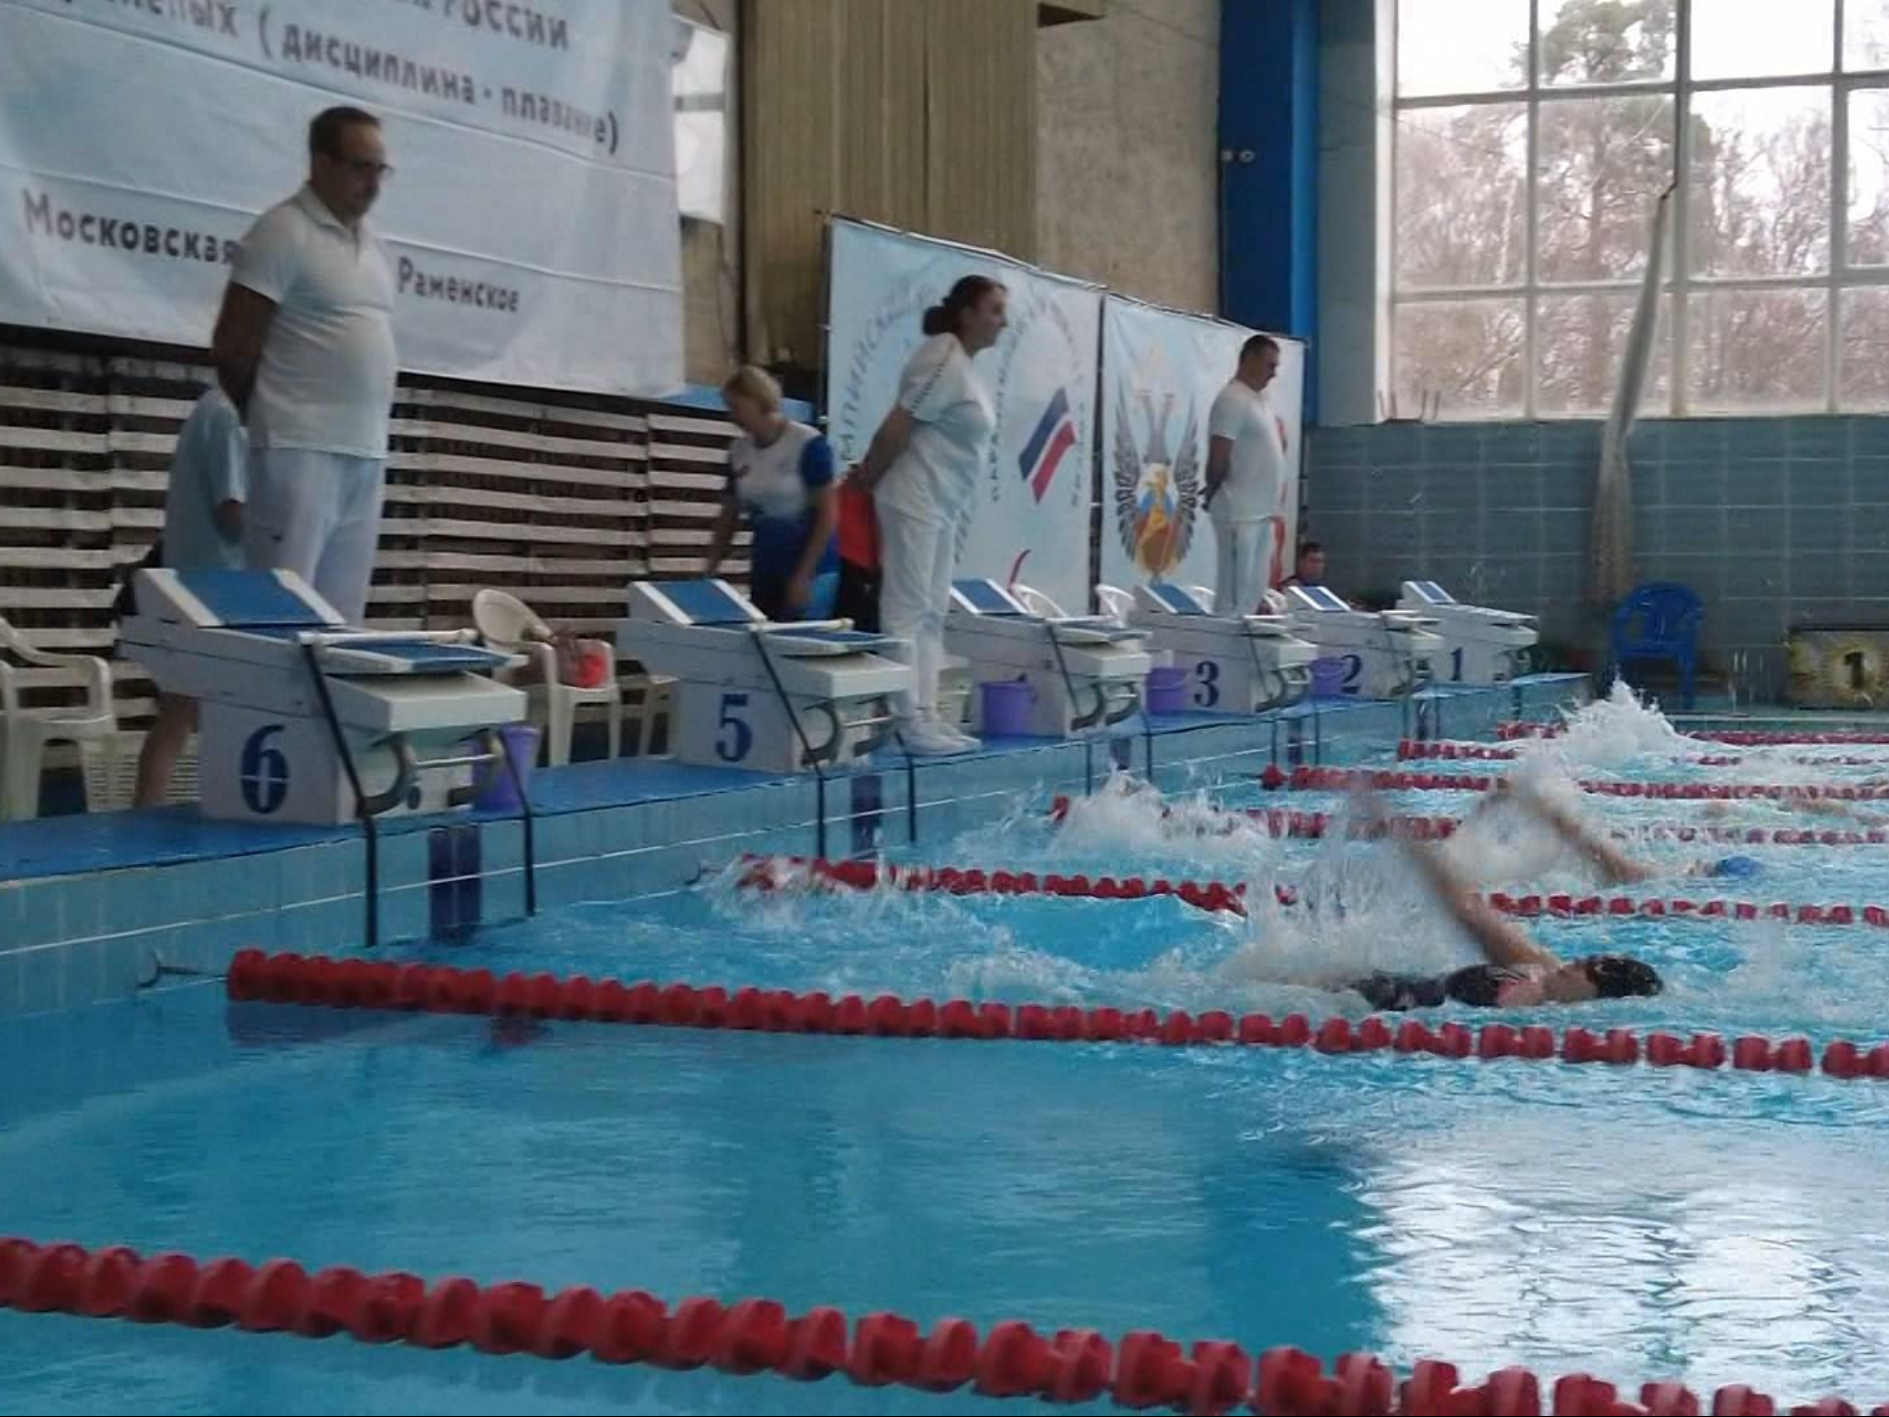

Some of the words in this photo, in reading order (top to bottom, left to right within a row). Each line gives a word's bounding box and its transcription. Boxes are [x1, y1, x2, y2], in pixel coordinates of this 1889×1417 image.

[1194, 660, 1220, 708] 3
[1340, 654, 1363, 694] 2
[1450, 647, 1464, 682] 1
[1843, 650, 1865, 690] 1
[714, 693, 753, 763] 5
[240, 723, 290, 815] 6
